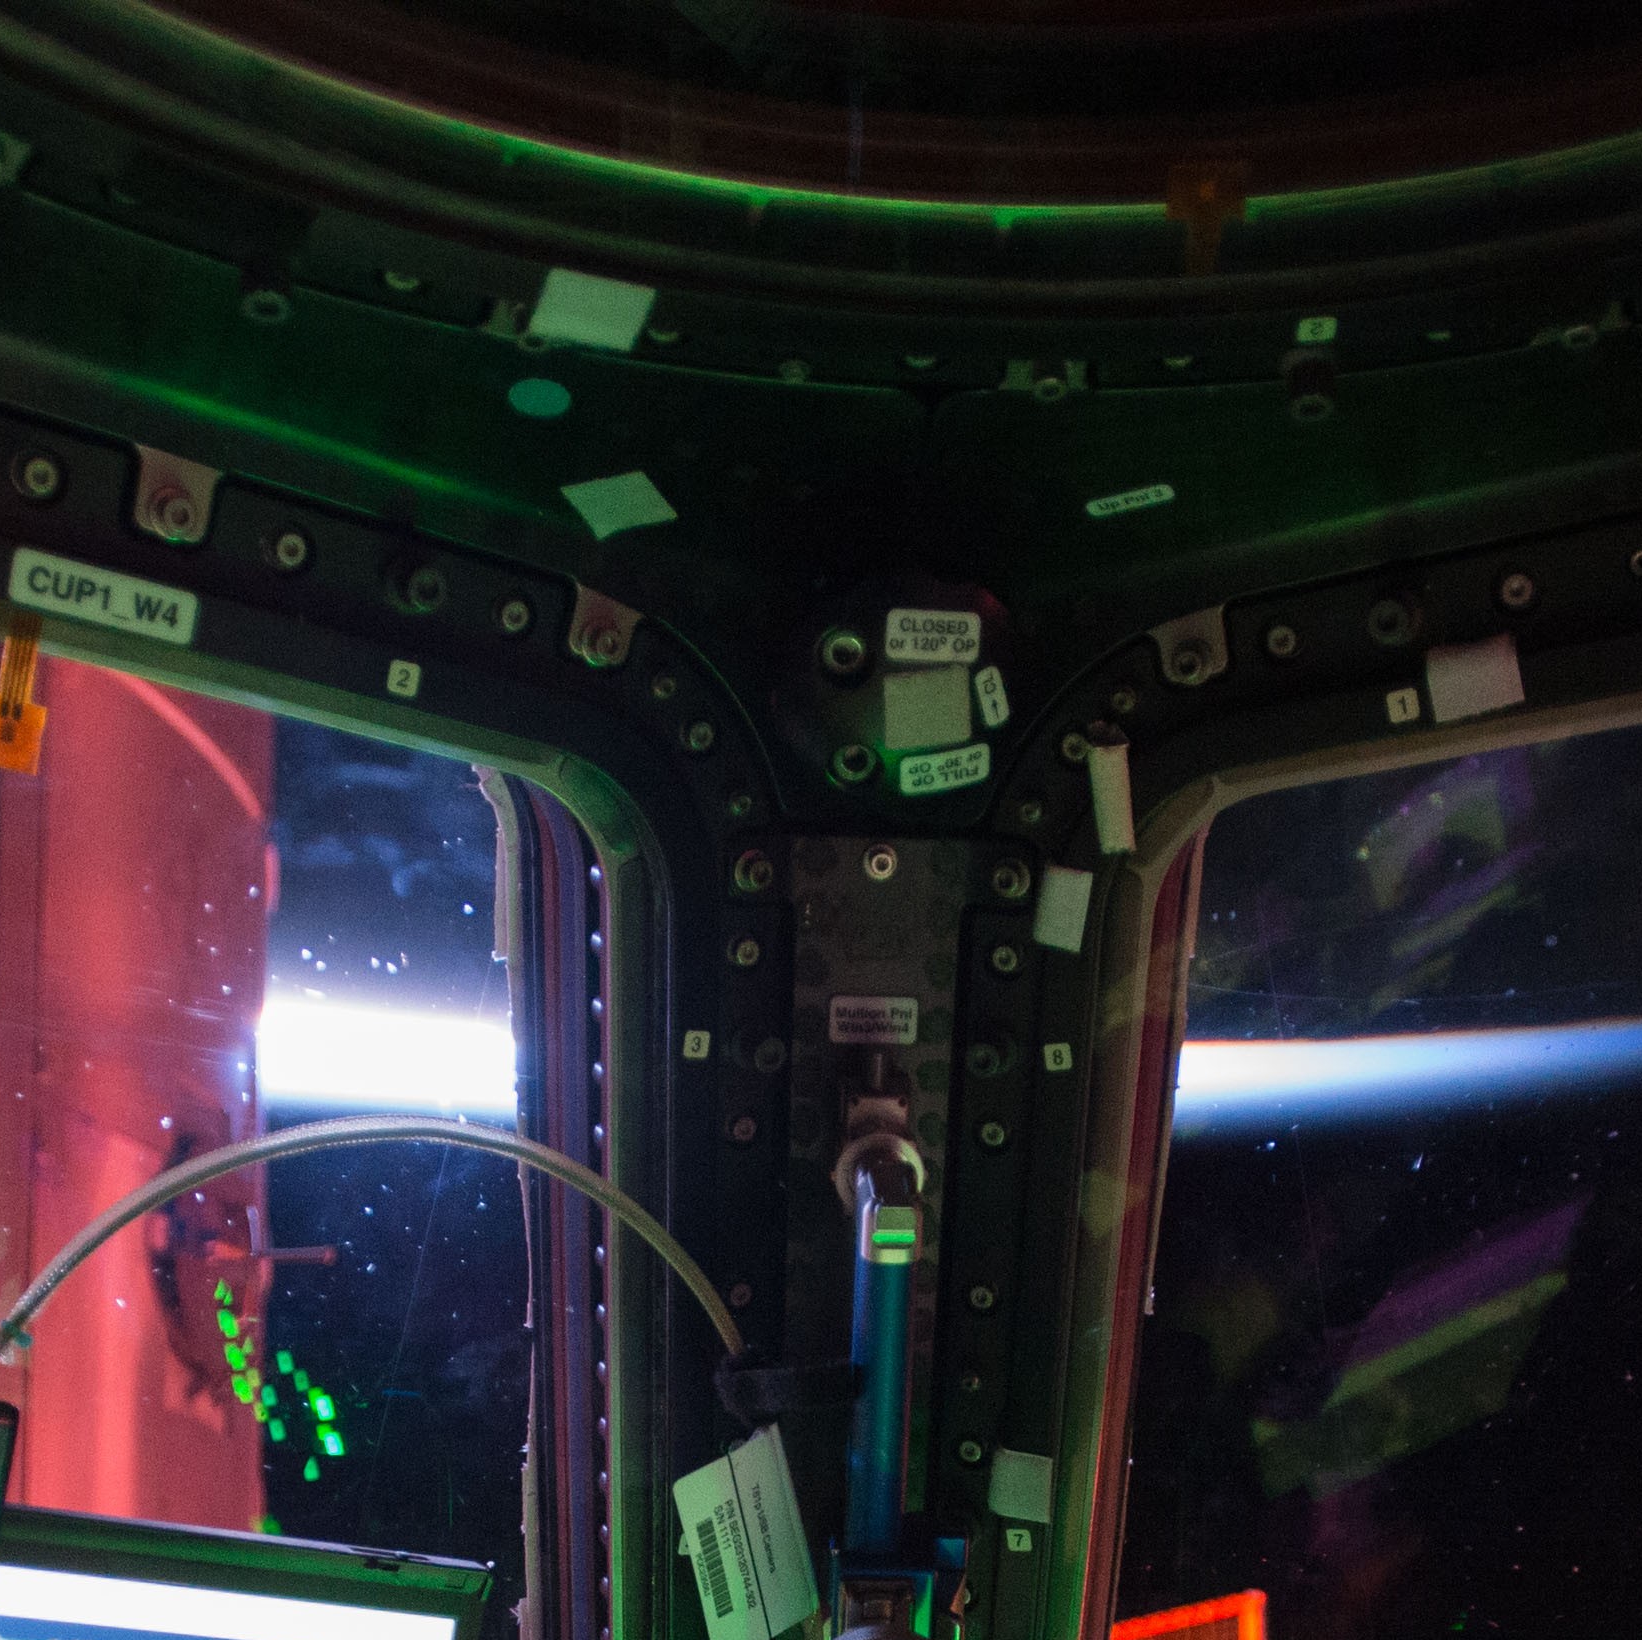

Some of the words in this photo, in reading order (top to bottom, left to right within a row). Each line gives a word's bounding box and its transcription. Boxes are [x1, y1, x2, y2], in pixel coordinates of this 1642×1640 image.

[27, 564, 180, 629] CUP1_W4
[900, 618, 969, 635] CLOSED
[889, 639, 905, 650] or
[953, 639, 976, 653] OP
[396, 667, 411, 688] 2
[1397, 697, 1407, 714] 1
[911, 773, 935, 786] OP
[939, 766, 978, 781] FULL
[691, 1036, 702, 1053] 3
[1052, 1049, 1063, 1066] 8
[1013, 1533, 1023, 1547] 7
